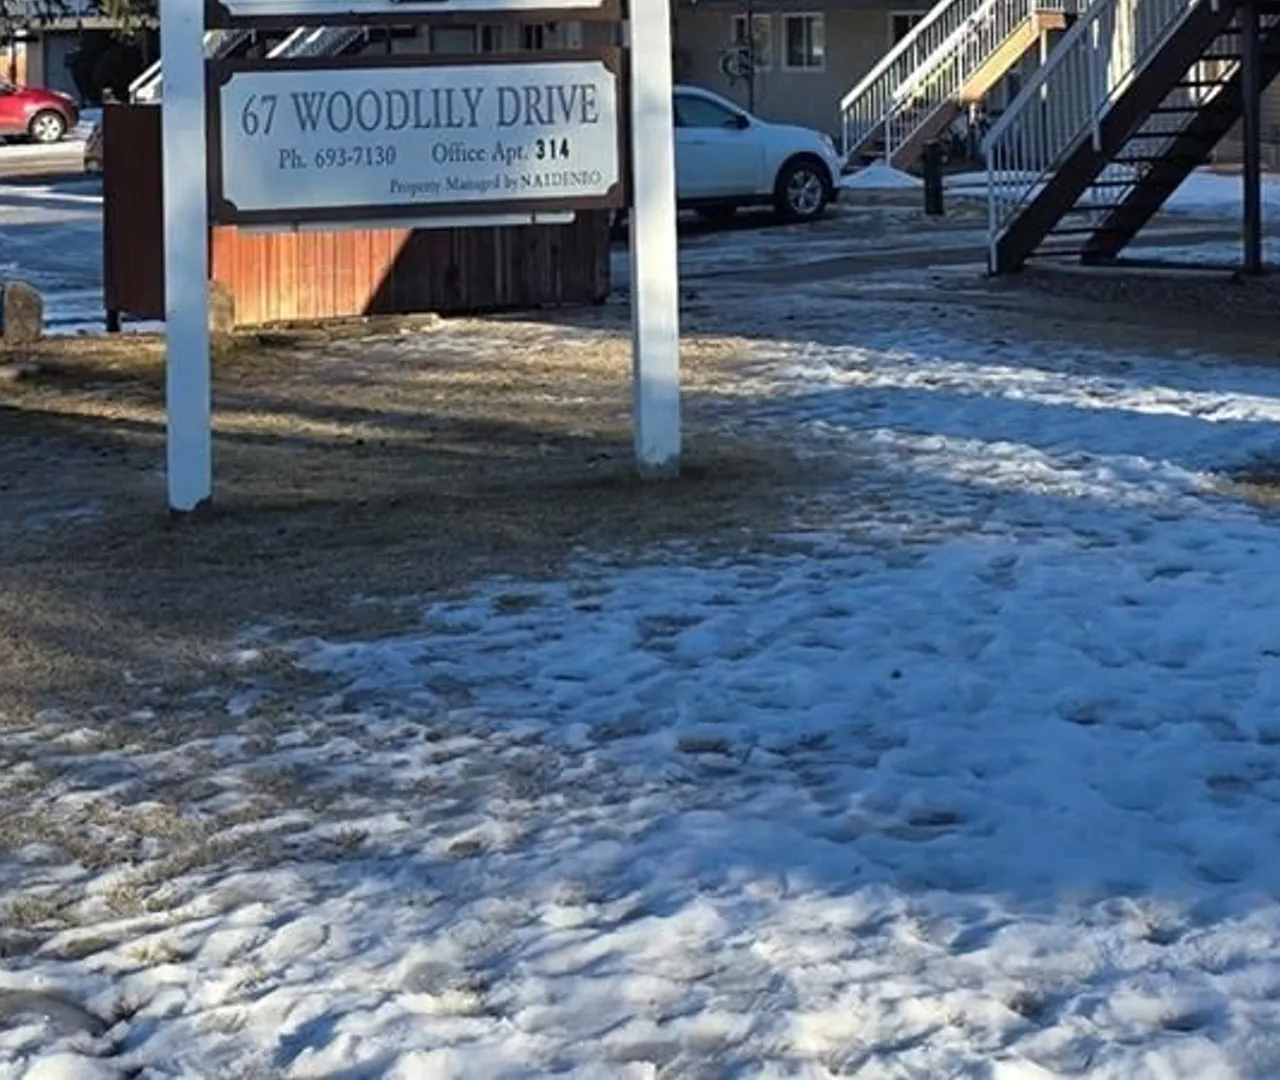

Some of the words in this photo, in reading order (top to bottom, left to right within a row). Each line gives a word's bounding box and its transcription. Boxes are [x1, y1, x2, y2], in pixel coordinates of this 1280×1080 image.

[241, 94, 278, 136] 67
[290, 87, 483, 133] WOODLILY
[496, 83, 600, 127] DRIVE
[278, 148, 307, 169] Ph.
[314, 145, 397, 169] 693-7130
[431, 141, 488, 165] Office
[491, 139, 529, 166] Apt.
[535, 136, 570, 160] 314
